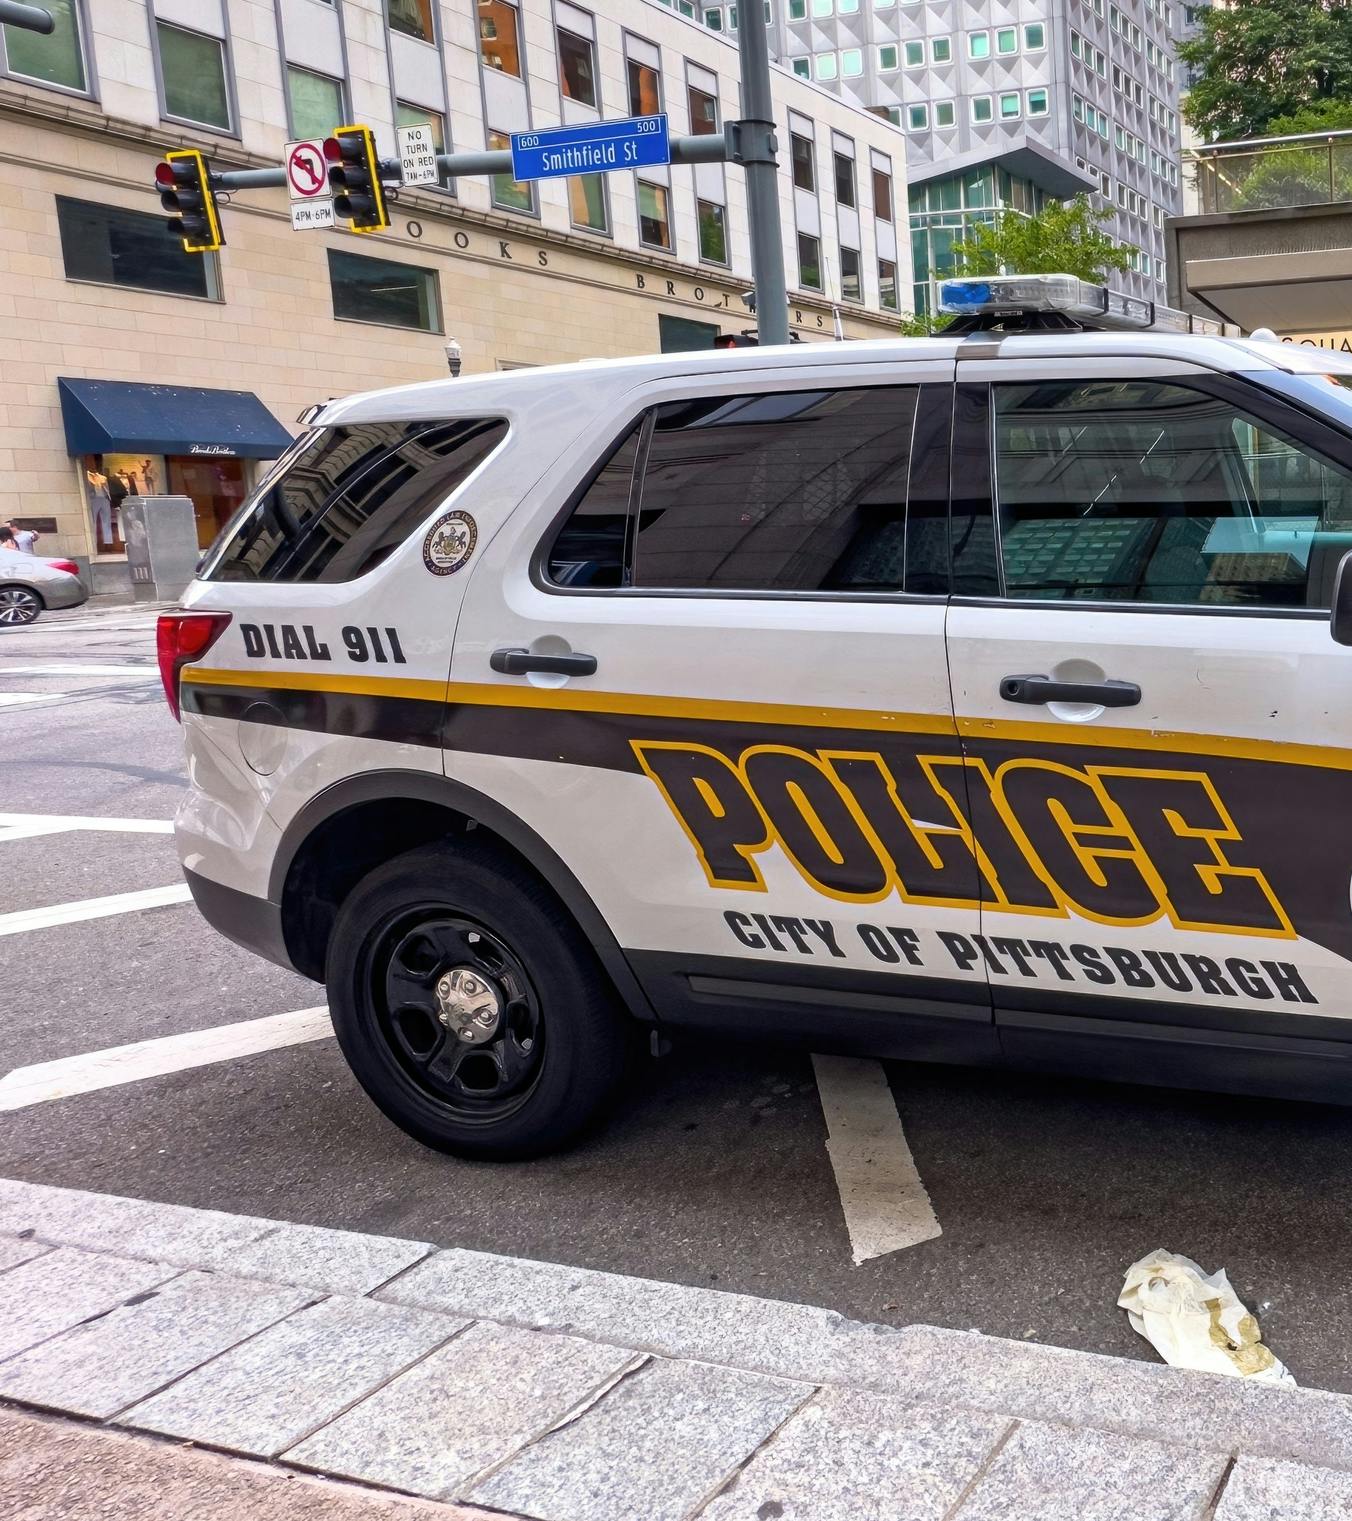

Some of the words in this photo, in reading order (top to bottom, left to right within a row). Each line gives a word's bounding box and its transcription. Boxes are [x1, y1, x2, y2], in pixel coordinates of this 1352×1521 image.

[405, 143, 428, 154] TURN
[407, 130, 422, 141] NO
[521, 135, 539, 147] 600
[637, 120, 656, 133] 500
[403, 159, 415, 168] ON
[418, 156, 434, 166] RED
[542, 142, 616, 171] Smithfield
[624, 140, 638, 161] St
[406, 220, 549, 267] OOKS
[636, 273, 824, 328] BROTRS
[240, 624, 332, 661] DIAL
[341, 625, 407, 664] 911
[629, 740, 1299, 940] POLICE
[723, 910, 846, 958] CITY
[857, 923, 923, 967] OF
[936, 930, 1319, 1004] PITTSBURGH
